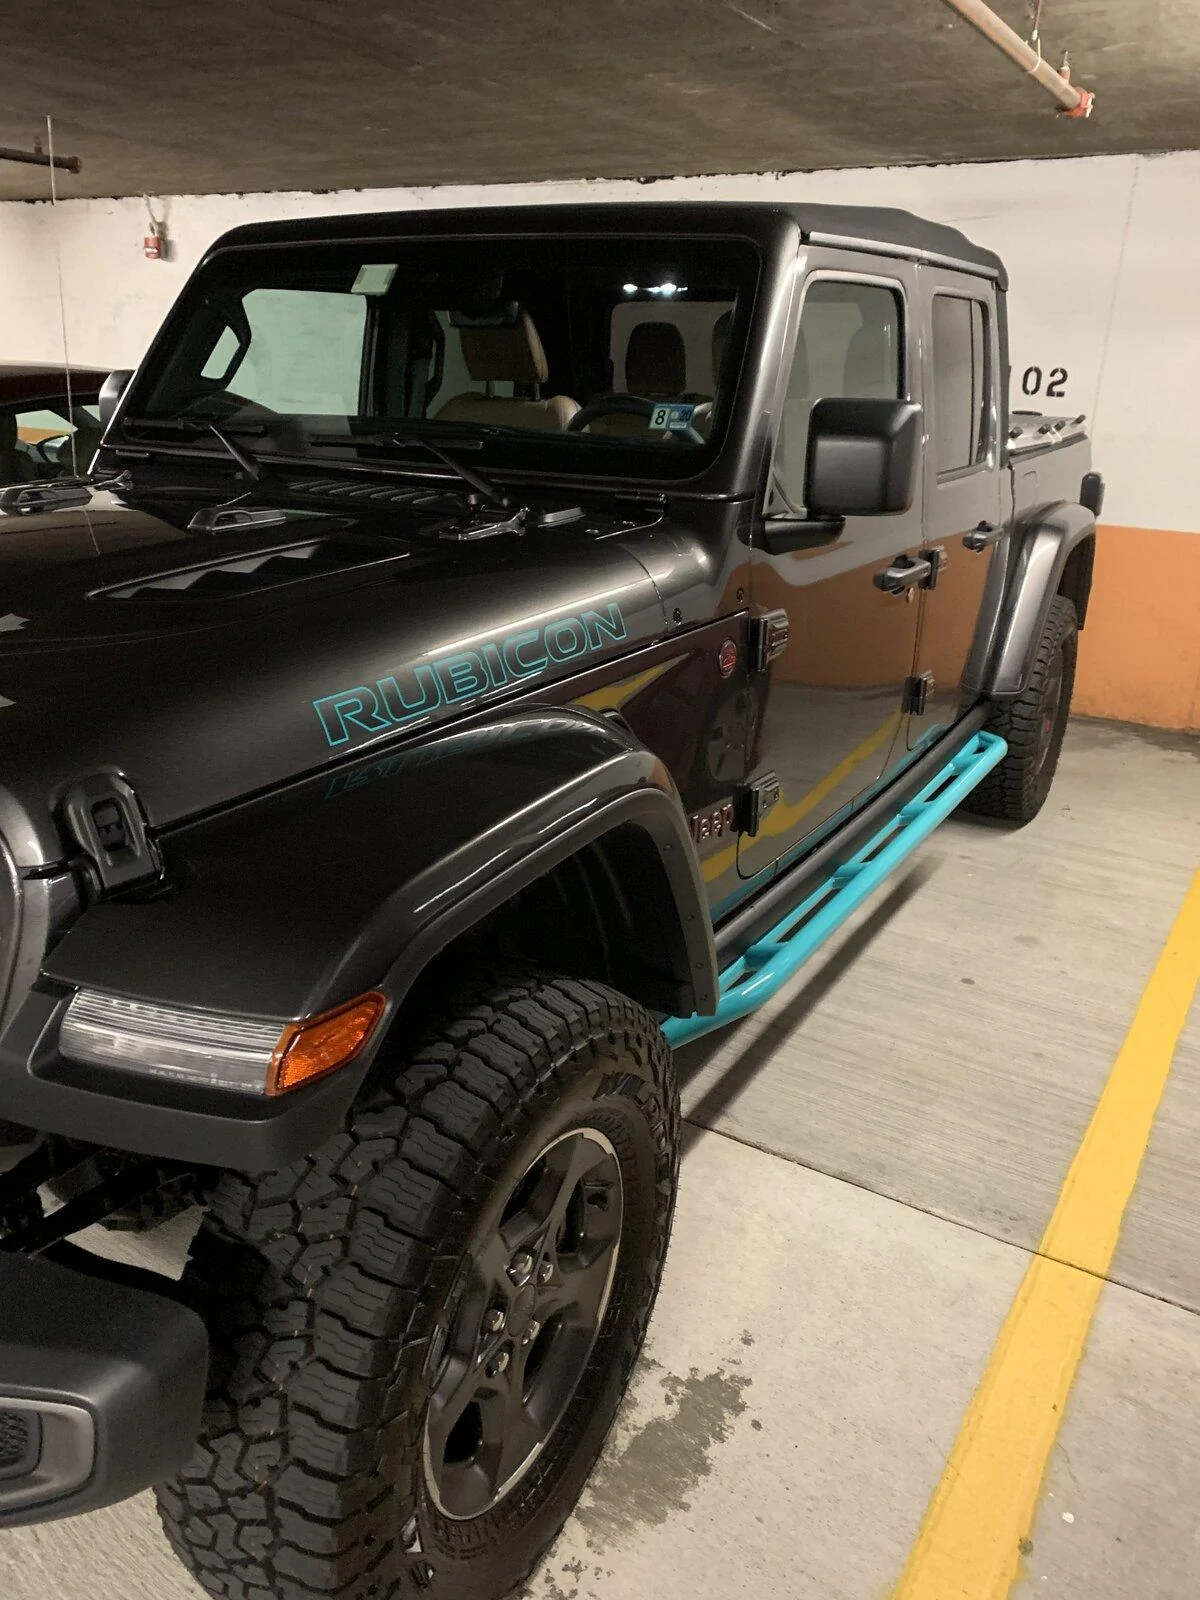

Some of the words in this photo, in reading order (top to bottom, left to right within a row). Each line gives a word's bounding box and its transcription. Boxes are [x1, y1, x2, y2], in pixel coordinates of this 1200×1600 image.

[1022, 366, 1068, 397] 02
[655, 409, 666, 425] 8
[313, 602, 627, 747] RUBICON
